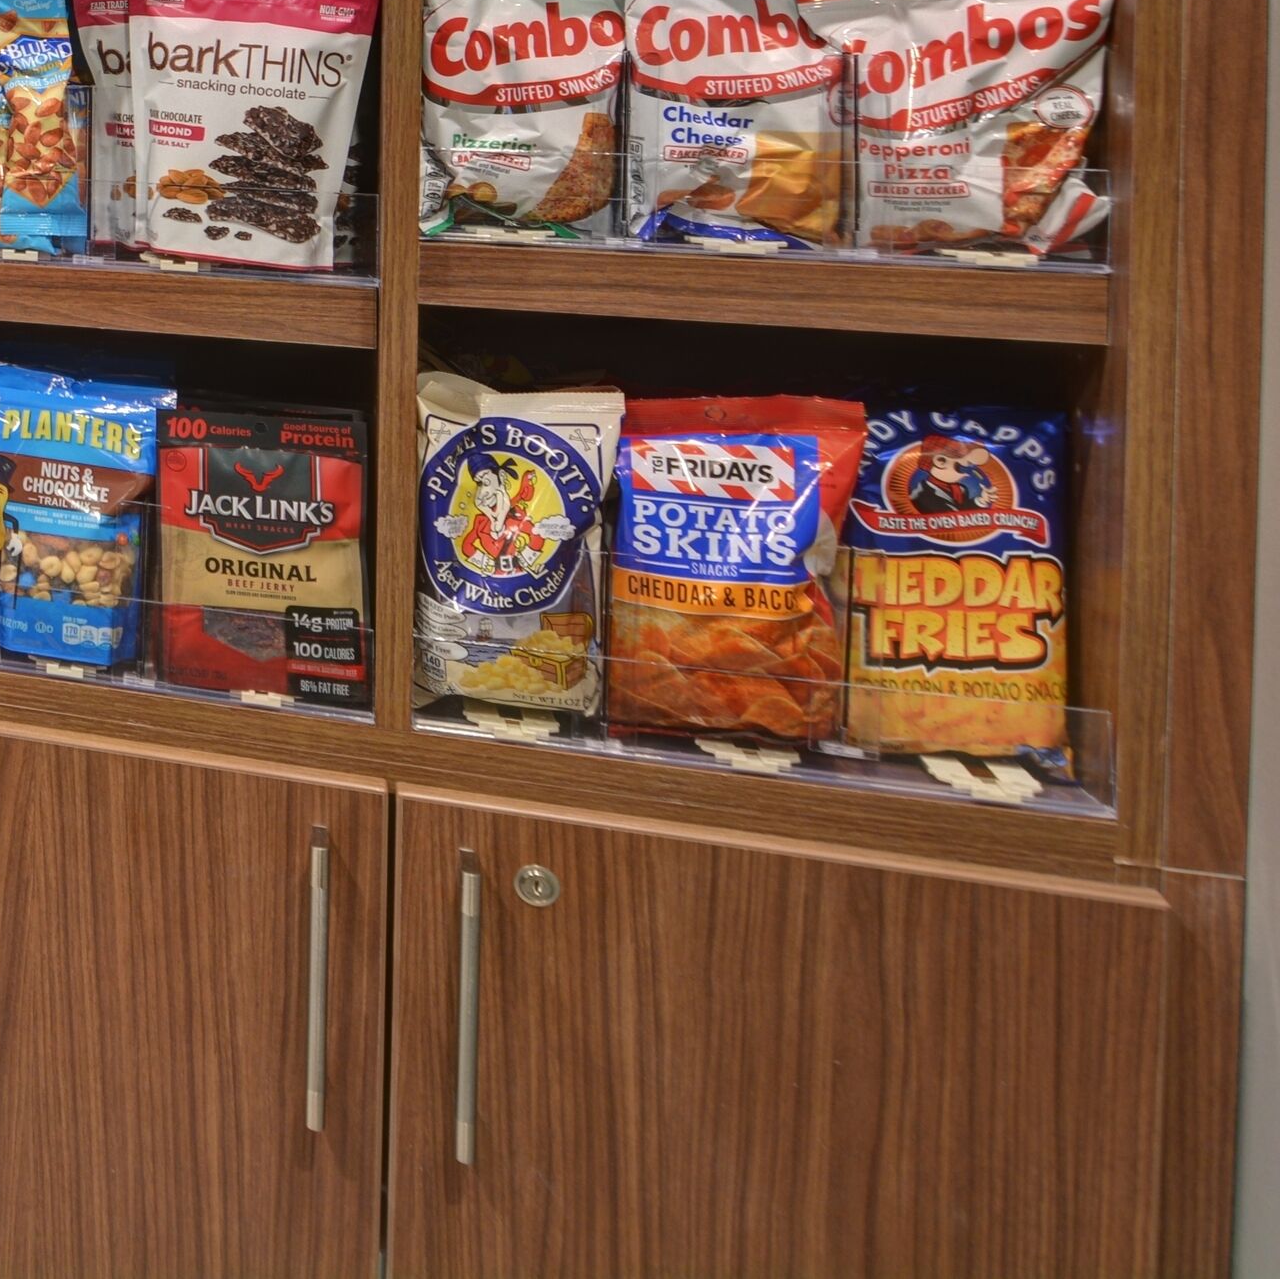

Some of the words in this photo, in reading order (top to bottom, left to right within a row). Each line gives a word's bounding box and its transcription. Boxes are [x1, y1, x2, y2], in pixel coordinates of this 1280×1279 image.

[148, 31, 345, 88] barkTHINS
[177, 78, 236, 96] snacking
[239, 84, 306, 100] chocolate
[496, 84, 553, 103] STUFFED
[559, 69, 615, 96] SNACKS
[705, 77, 773, 96] STUFFED
[777, 65, 832, 89] SNACKS
[663, 106, 754, 129] Cheddar
[671, 127, 742, 146] Cheese
[859, 138, 971, 162] Pepperoni
[884, 164, 949, 180] Pizza
[2, 408, 142, 460] PLANTERS
[167, 416, 208, 440] 100
[210, 425, 252, 437] Calories
[280, 430, 354, 449] Protein
[283, 423, 306, 433] Good
[308, 424, 334, 434] Source
[336, 424, 351, 435] of
[41, 461, 79, 482] NUTS
[82, 471, 94, 484] &
[653, 455, 664, 474] TGI
[667, 457, 774, 484] FRIDAYS
[23, 477, 110, 503] CHOCOLATE
[184, 489, 253, 520] JACK
[255, 495, 335, 525] LINK'S
[633, 499, 794, 535] POTATO
[878, 515, 908, 530] TASTE
[909, 516, 927, 530] THE
[928, 515, 957, 529] OVEN
[958, 514, 991, 527] BAKED
[993, 514, 1038, 529] CRUNCH!
[632, 525, 798, 567] SKINS
[205, 557, 317, 582] ORIGINAL
[690, 562, 738, 578] SNACKS
[227, 578, 255, 588] BEEF
[260, 582, 295, 593] JERKY
[434, 558, 464, 596] Aged
[464, 582, 513, 609] White
[515, 563, 566, 604] Cheddar
[871, 609, 1046, 664] FRIES
[294, 641, 322, 657] 100
[324, 647, 355, 660] CALORIES
[301, 679, 317, 693] 96%
[318, 682, 331, 694] FAT
[332, 683, 349, 696] FREE
